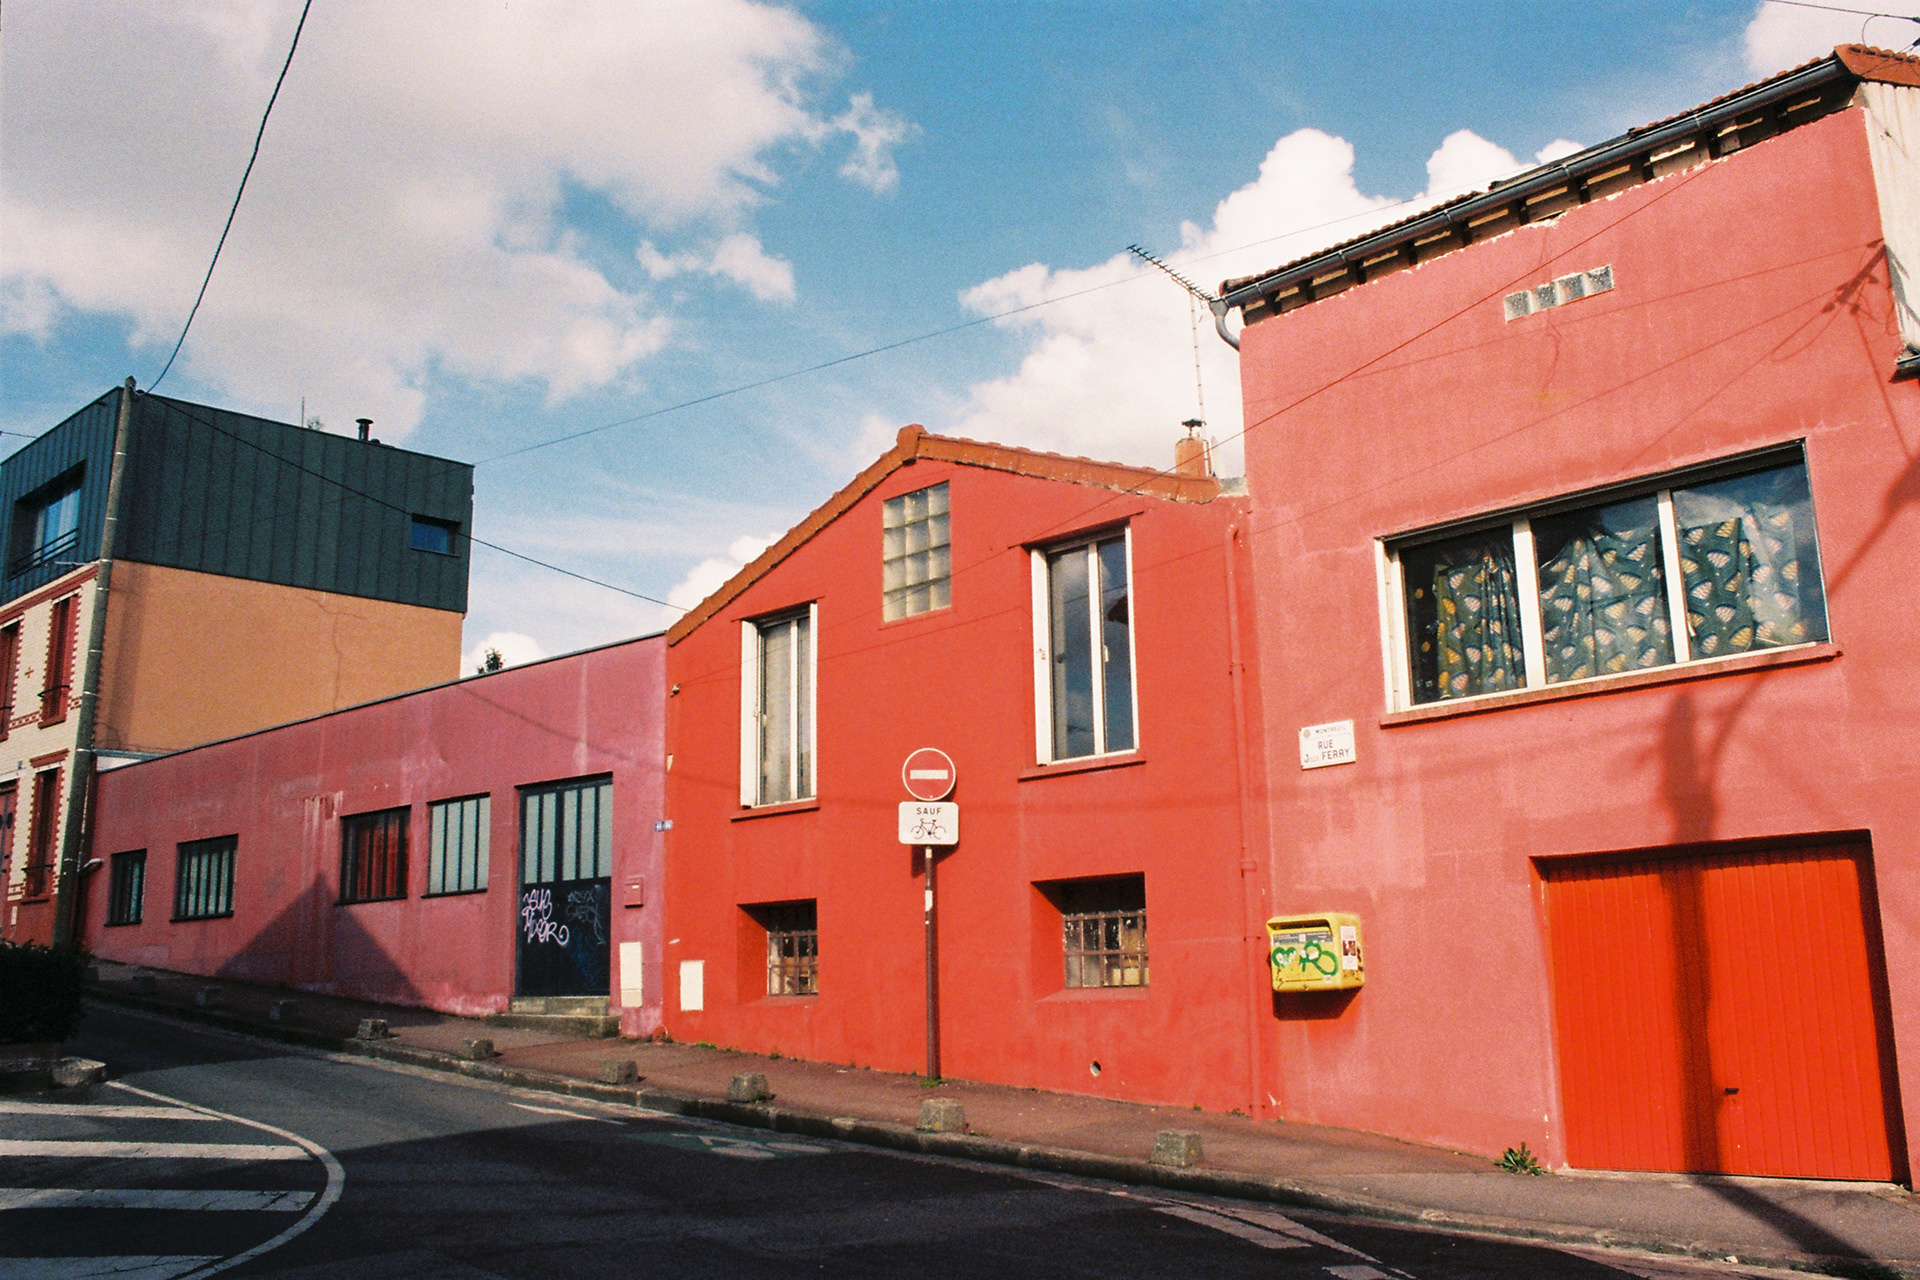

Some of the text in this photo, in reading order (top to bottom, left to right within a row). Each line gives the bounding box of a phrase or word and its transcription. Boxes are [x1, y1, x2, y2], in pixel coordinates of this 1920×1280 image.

[1318, 739, 1334, 750] RUE
[1321, 748, 1350, 760] FERRY
[916, 807, 941, 815] SAUF
